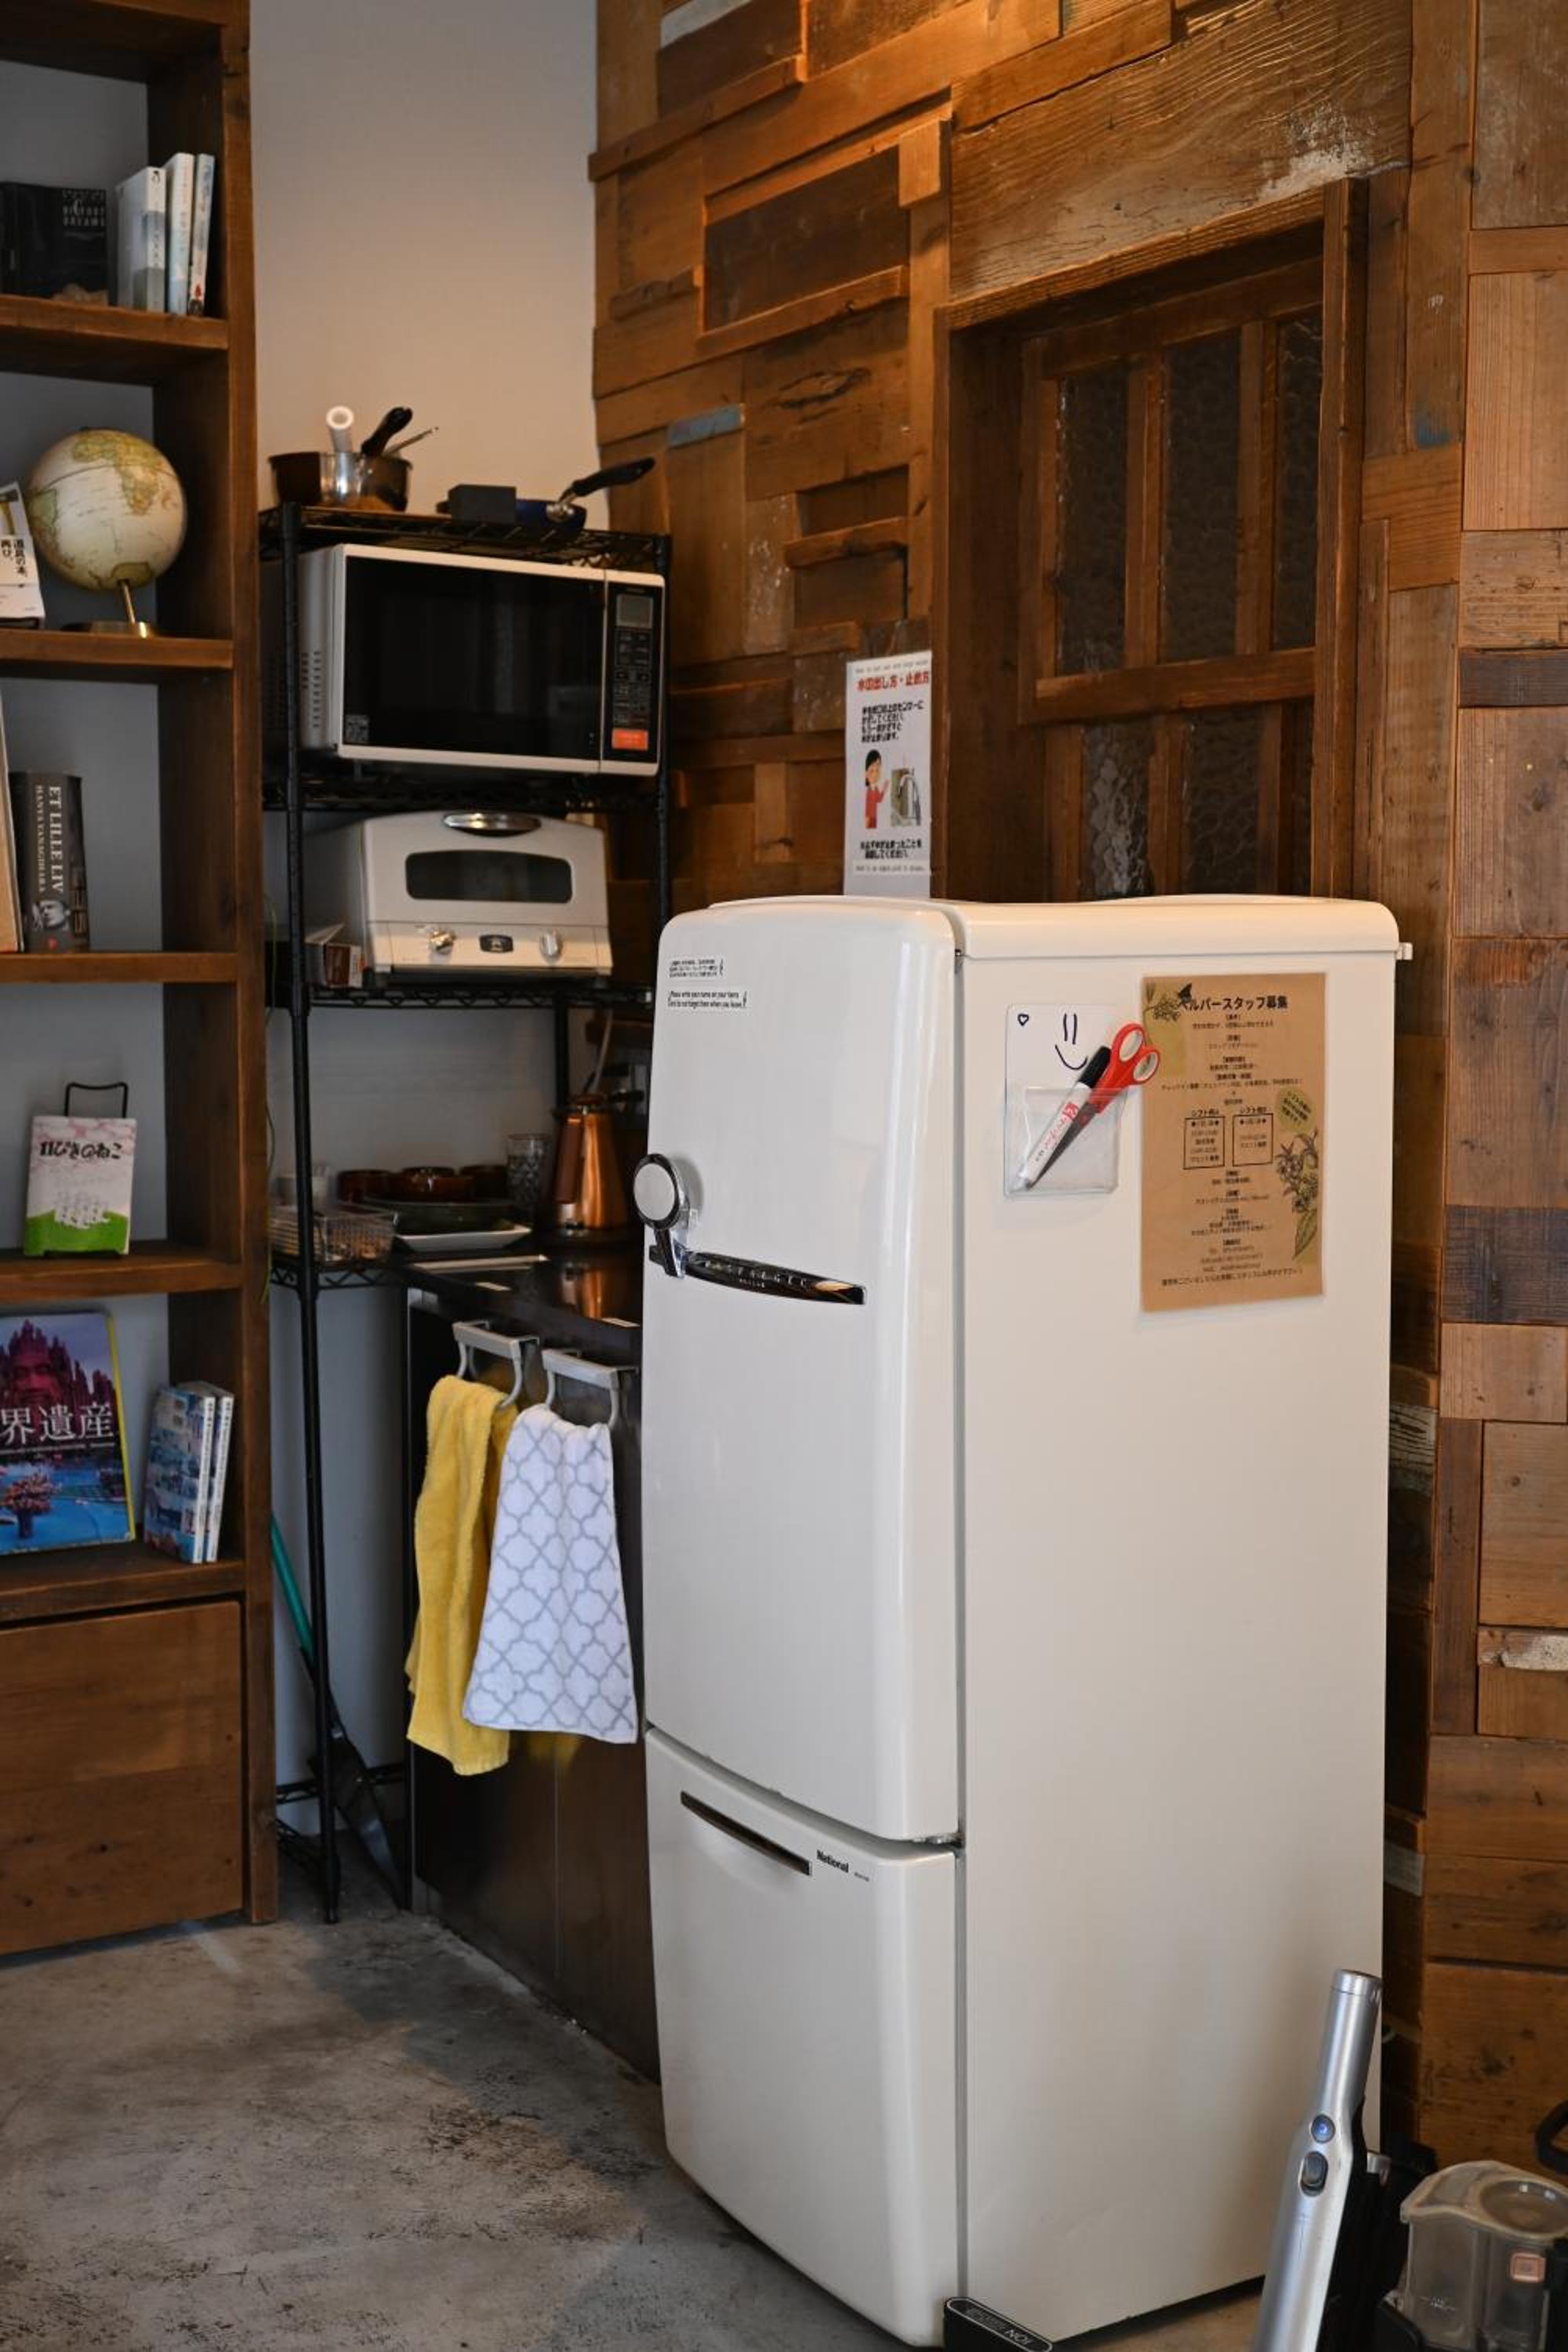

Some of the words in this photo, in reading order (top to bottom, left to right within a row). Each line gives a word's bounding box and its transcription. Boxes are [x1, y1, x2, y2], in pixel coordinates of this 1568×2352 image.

[49, 786, 62, 809] ET
[49, 813, 62, 860] LILLE
[51, 864, 64, 894] LIV
[39, 1141, 123, 1160] 11ぴきのねこ
[0, 1402, 114, 1445] 界遺産
[816, 1849, 849, 1873] National
